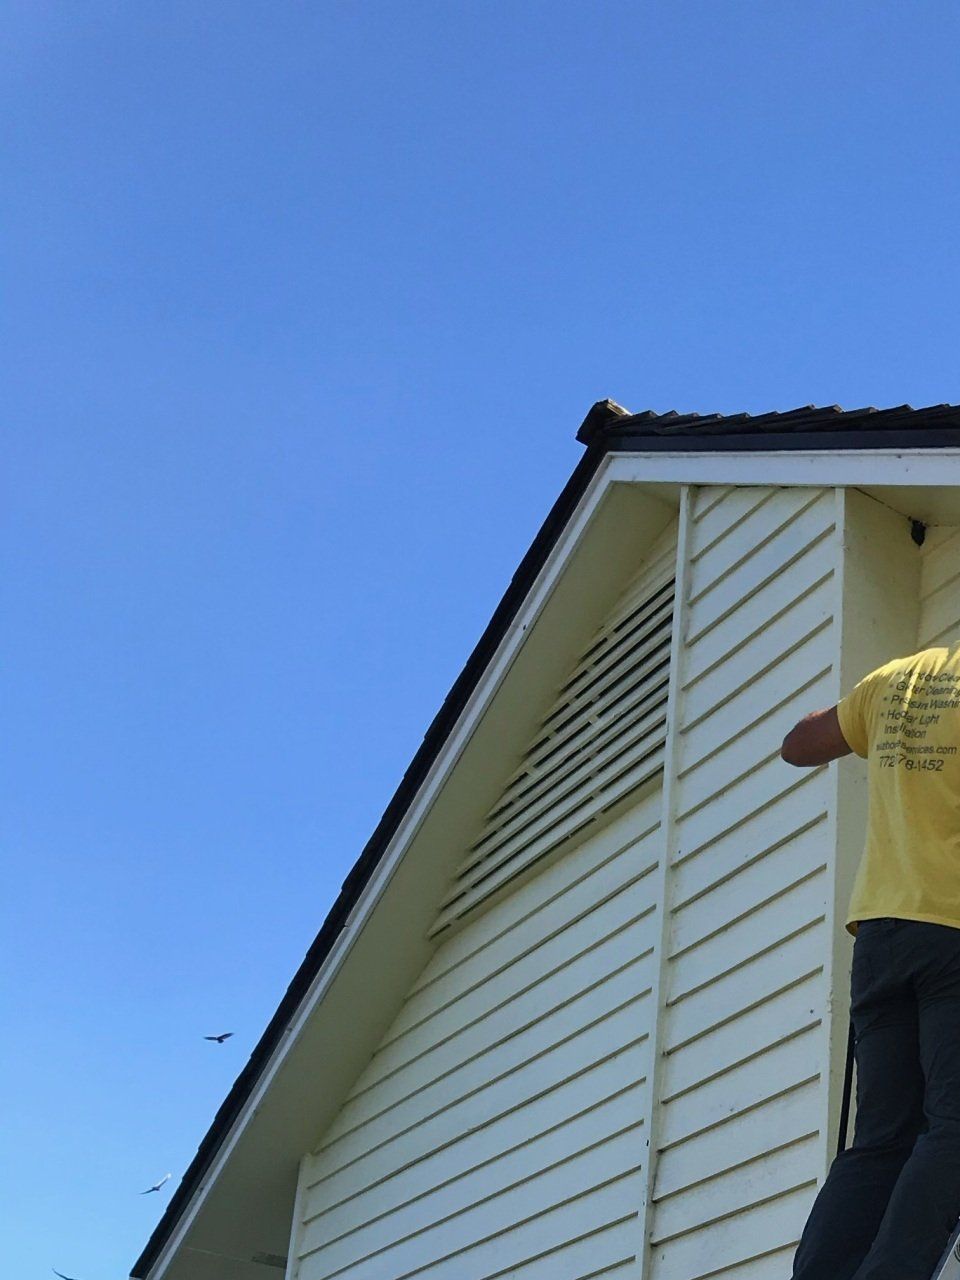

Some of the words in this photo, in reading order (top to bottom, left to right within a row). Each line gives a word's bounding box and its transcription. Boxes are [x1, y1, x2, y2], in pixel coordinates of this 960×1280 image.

[896, 681, 926, 695] Gter
[891, 694, 929, 710] Prsure
[887, 709, 918, 724] Hoday
[885, 723, 927, 739] Insllation
